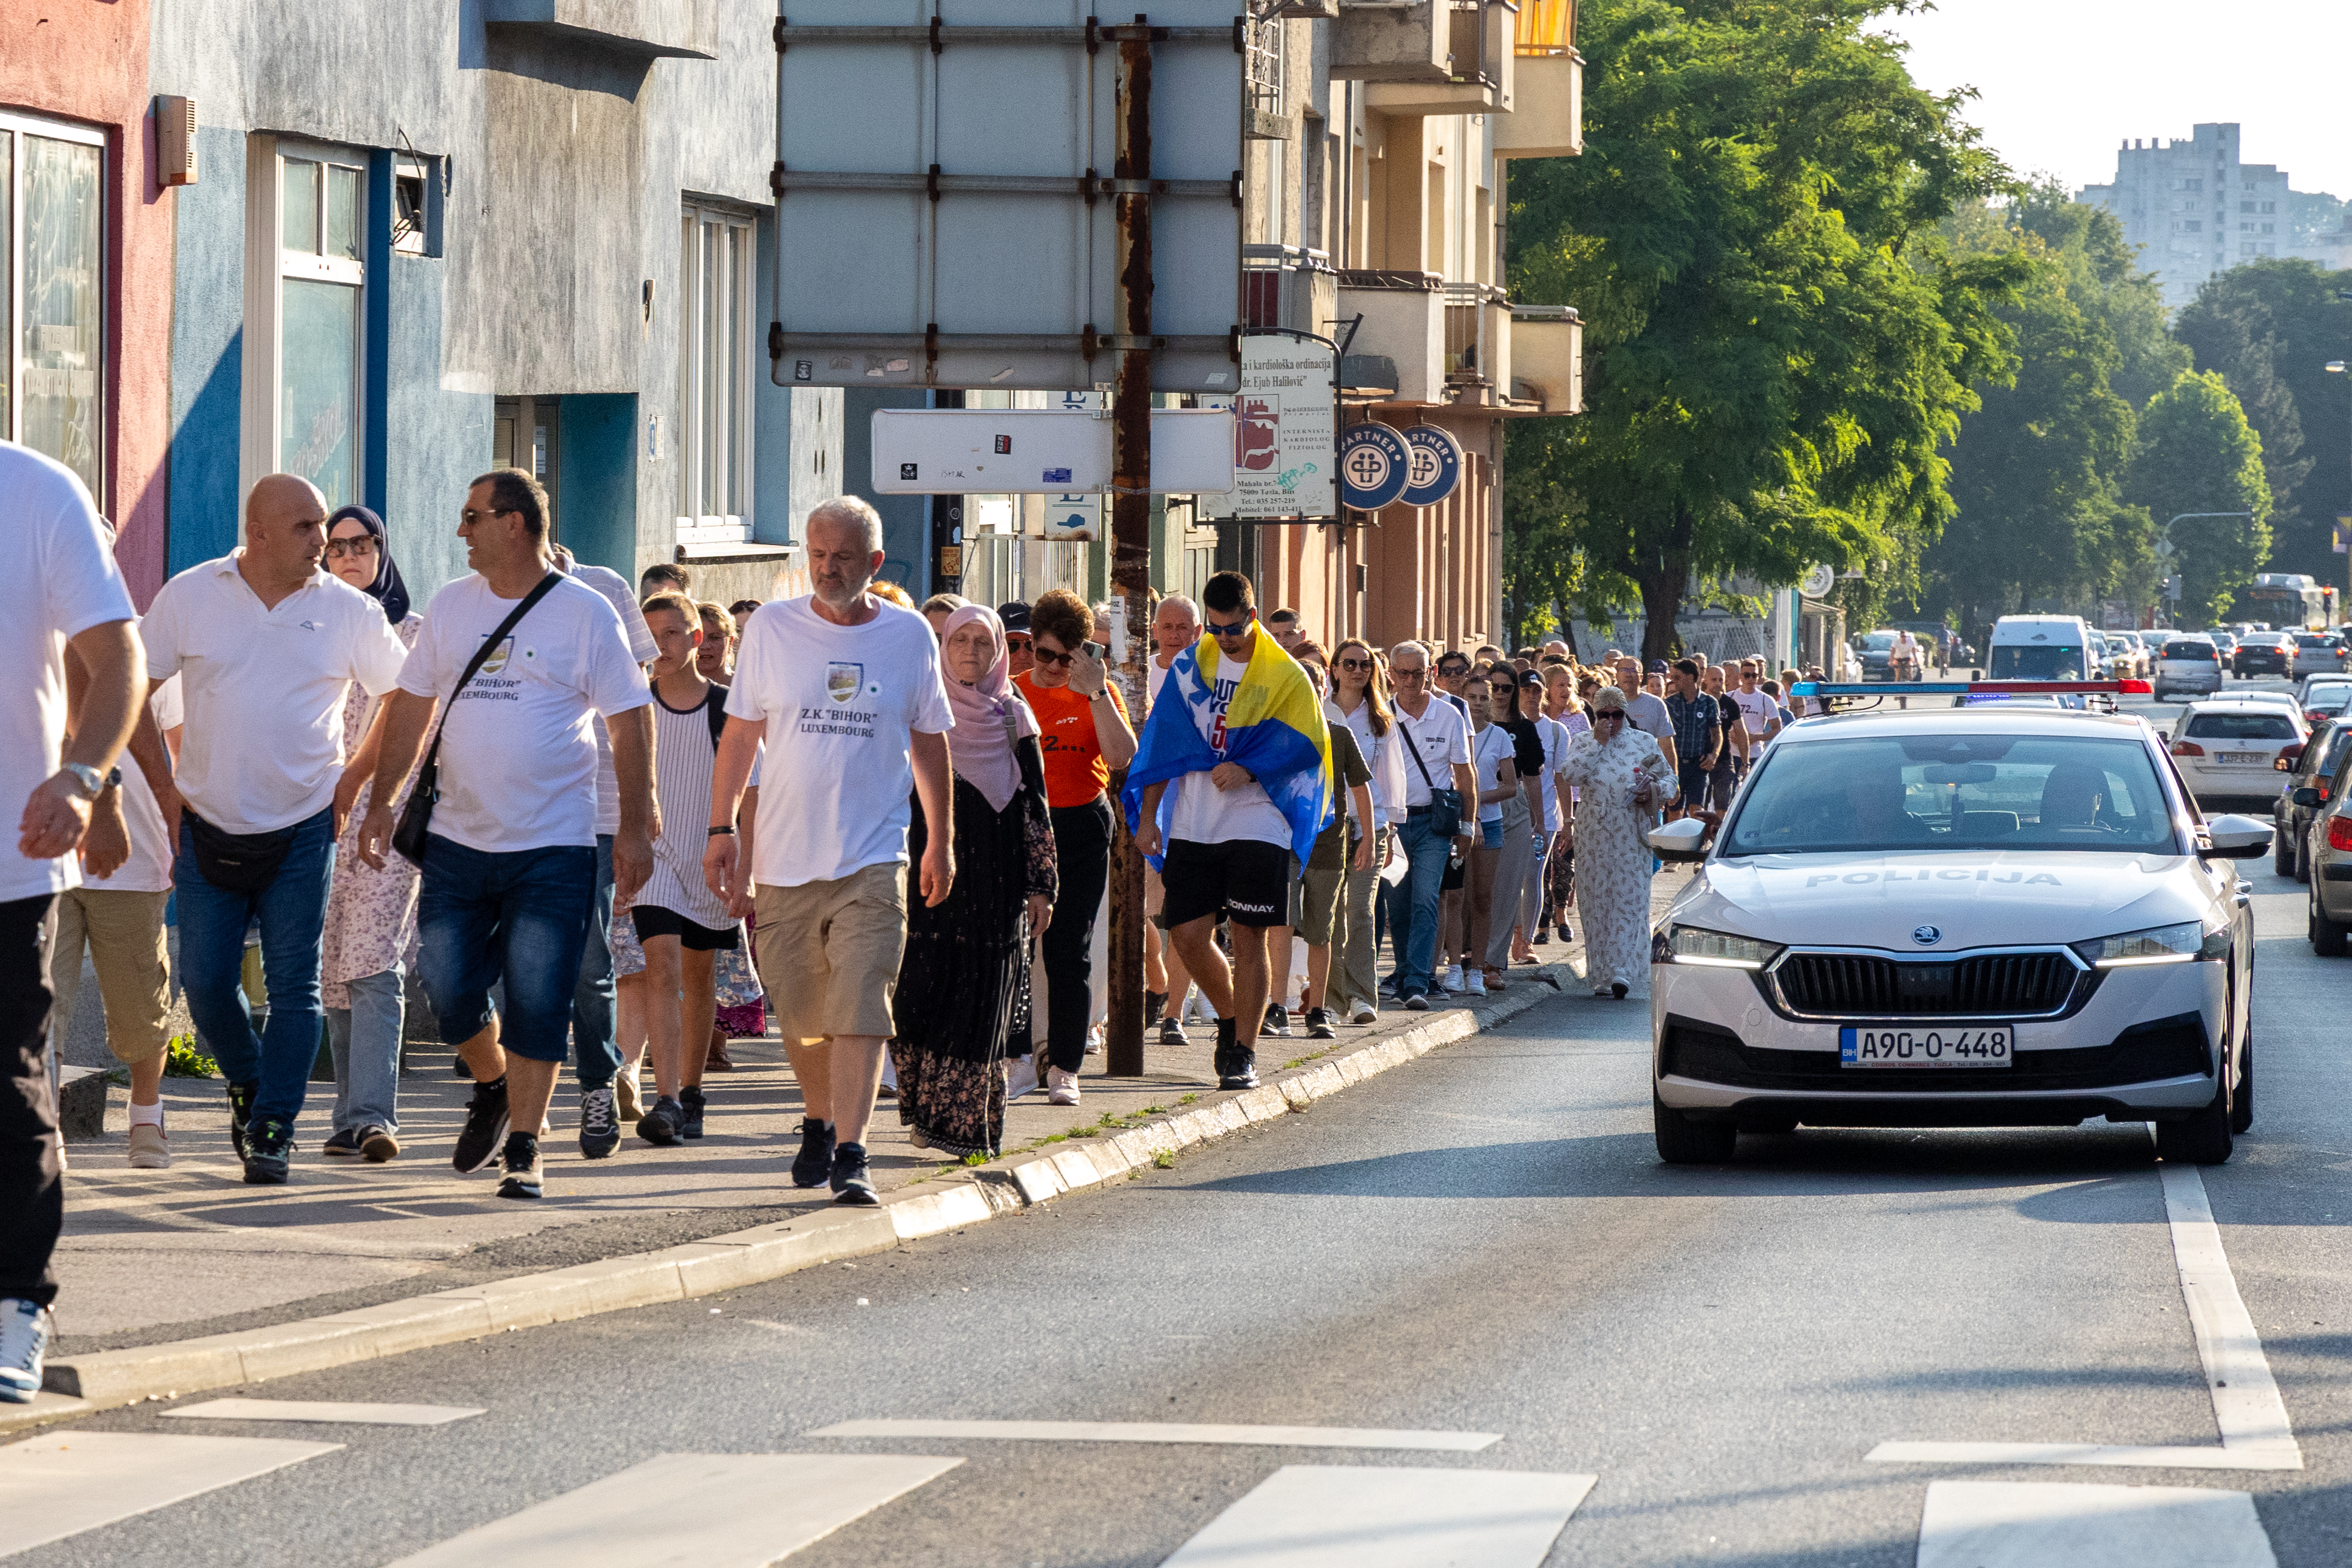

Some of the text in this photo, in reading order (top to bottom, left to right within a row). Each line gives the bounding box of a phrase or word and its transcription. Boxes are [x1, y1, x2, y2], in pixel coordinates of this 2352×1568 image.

[1253, 359, 1294, 371] kardiološka
[1296, 358, 1331, 372] ordinacija
[1242, 377, 1252, 388] dr.
[1254, 376, 1271, 390] Ejub
[459, 691, 519, 700] XEMBOURG
[801, 709, 824, 720] Z.K.
[801, 724, 874, 738] LUXEMBOURG
[1806, 869, 2063, 887] POLICIJA
